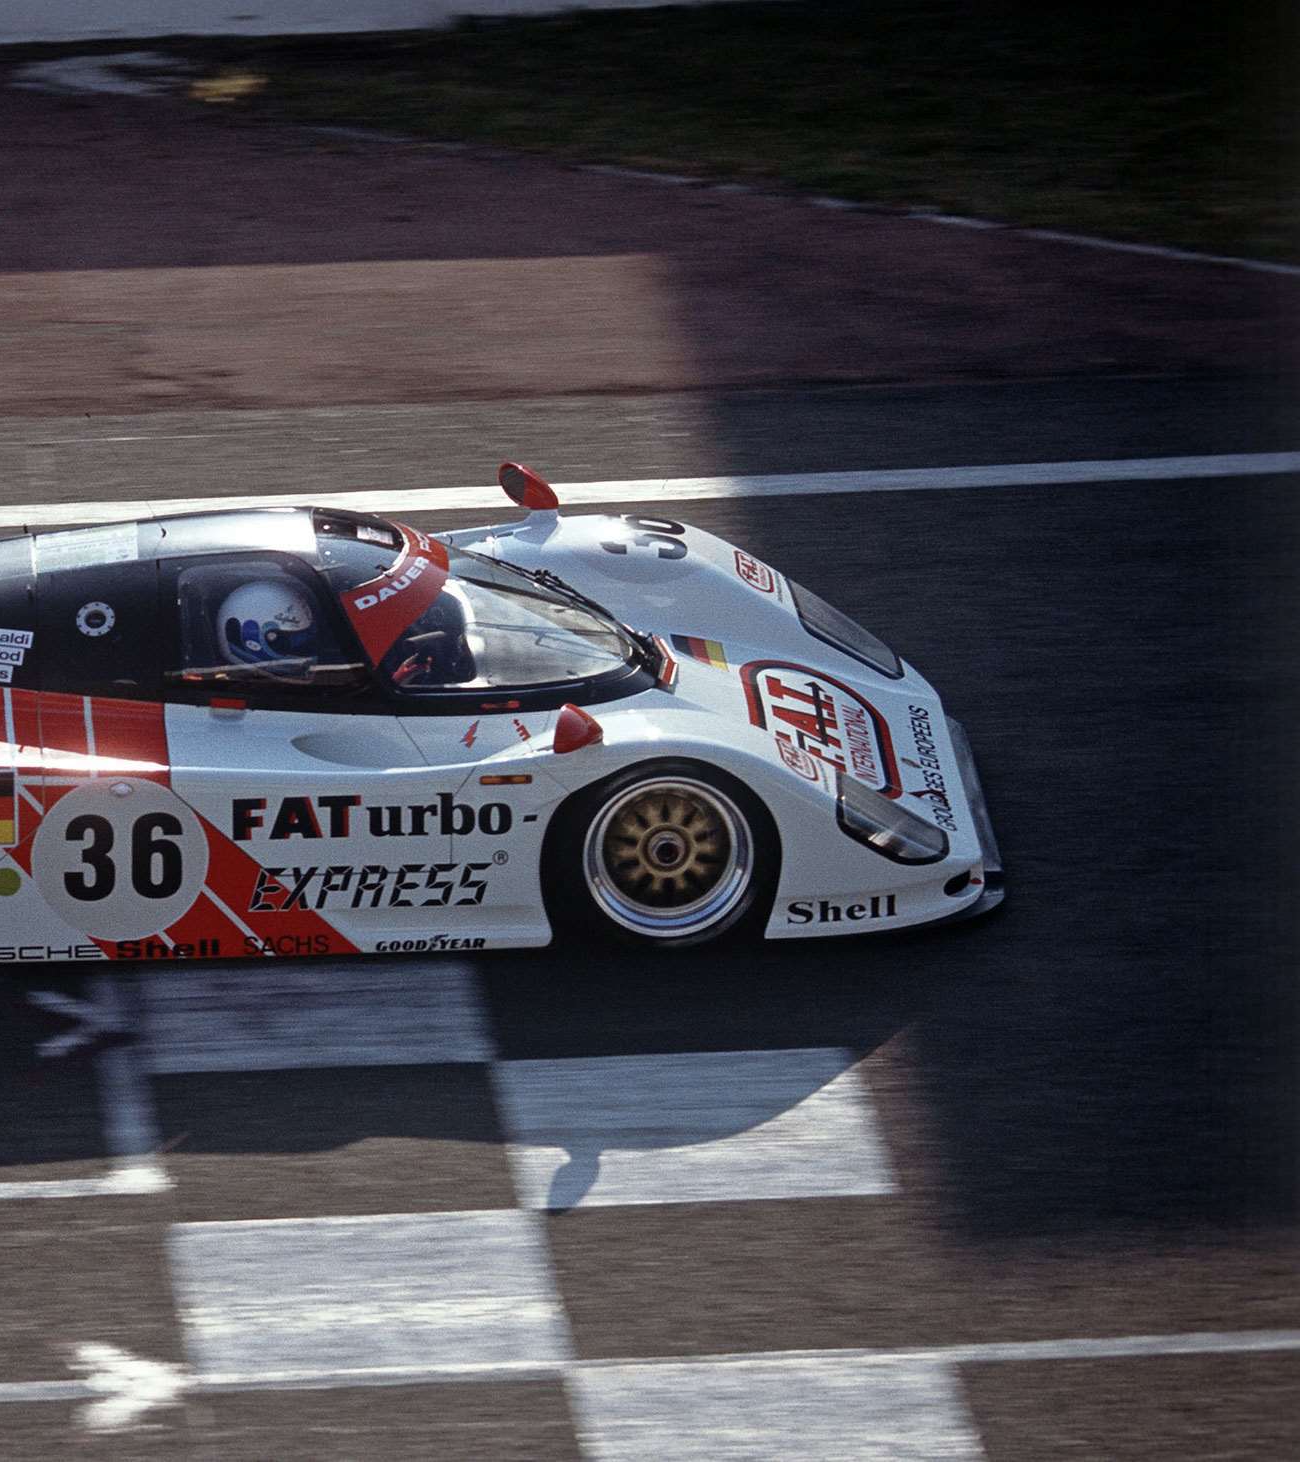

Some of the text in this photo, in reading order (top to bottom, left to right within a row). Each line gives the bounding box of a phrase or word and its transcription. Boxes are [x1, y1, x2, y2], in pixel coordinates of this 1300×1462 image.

[354, 556, 430, 610] DAUER
[841, 704, 879, 786] INTERNATIONAL
[64, 812, 183, 902] 36
[787, 894, 897, 924] Shell
[116, 938, 220, 958] Shell
[244, 935, 330, 954] SACHS
